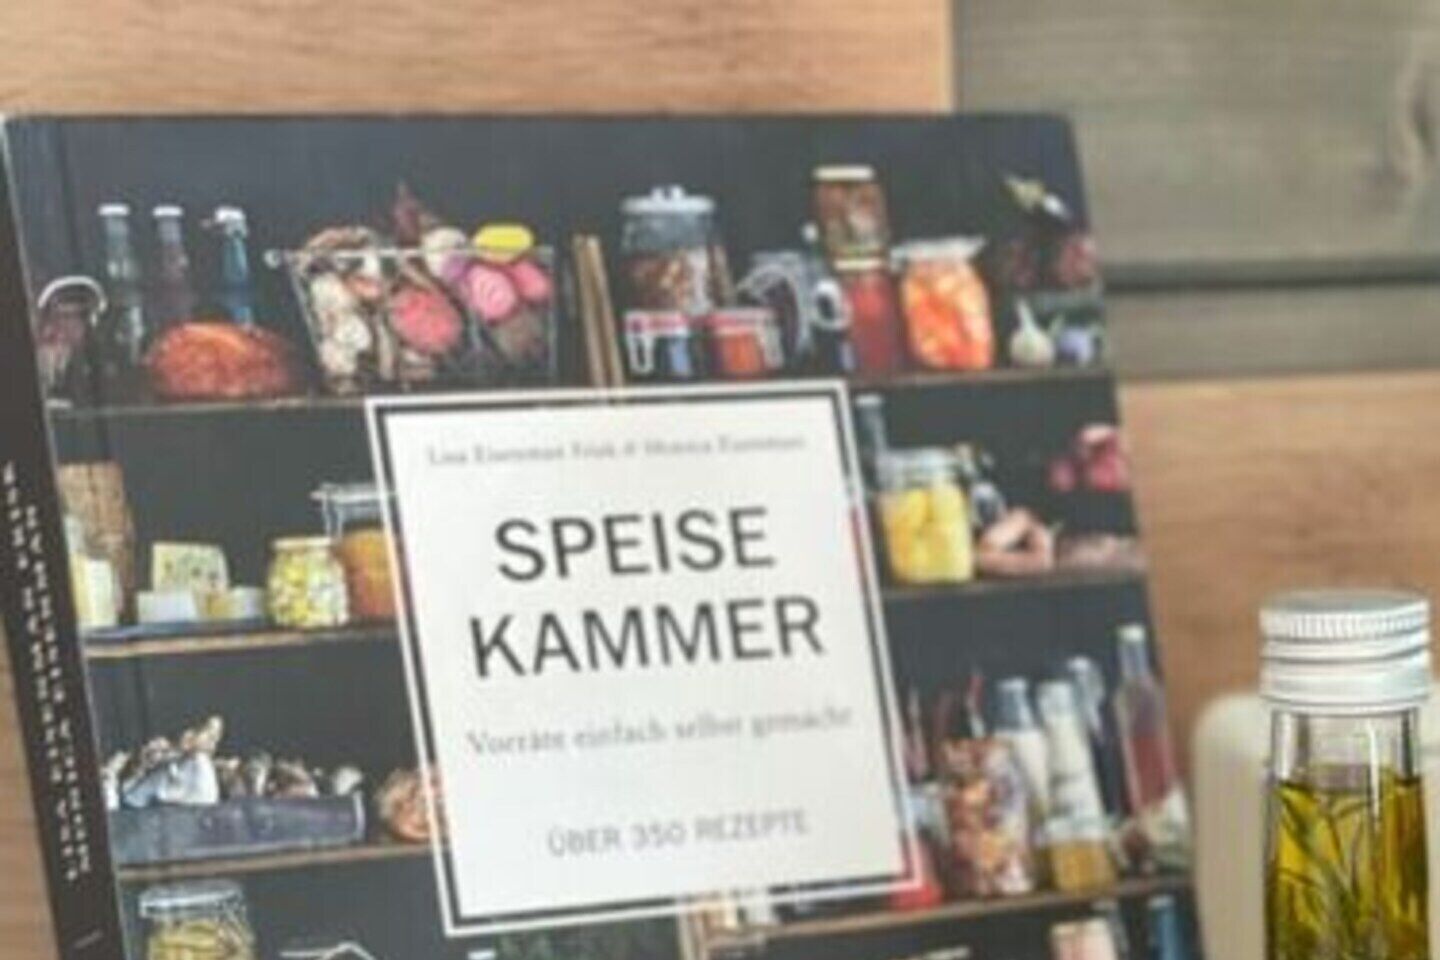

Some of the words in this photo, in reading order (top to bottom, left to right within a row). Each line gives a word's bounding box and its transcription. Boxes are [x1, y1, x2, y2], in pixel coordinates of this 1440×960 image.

[494, 505, 778, 583] SPEISE
[469, 594, 827, 680] KAMMER
[464, 724, 570, 757] Vorräte
[574, 717, 669, 751] einfach
[675, 713, 745, 739] selbst
[750, 703, 854, 738] gemacht
[545, 826, 626, 858] ÜBER
[632, 822, 688, 850] 350
[694, 808, 812, 845] REZEPTE
